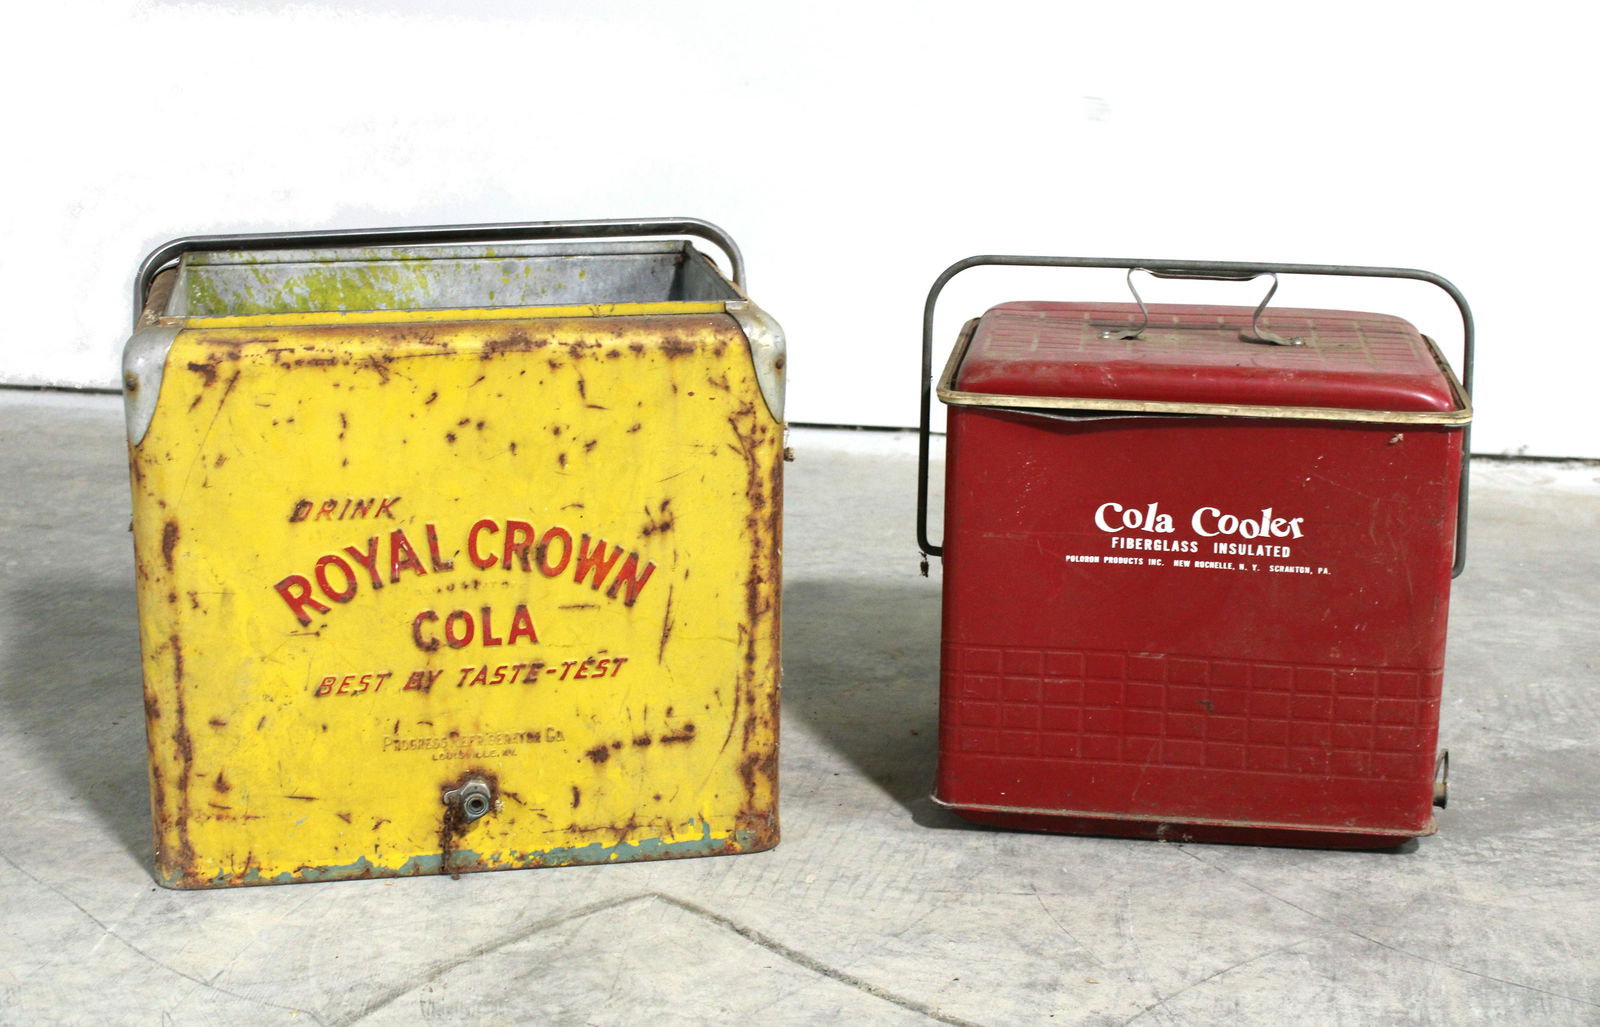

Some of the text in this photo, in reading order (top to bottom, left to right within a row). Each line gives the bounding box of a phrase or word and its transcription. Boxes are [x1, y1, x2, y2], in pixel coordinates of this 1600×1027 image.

[288, 495, 402, 523] DRINK
[1094, 502, 1304, 540] Cola Cooler
[1111, 536, 1291, 558] FIBERGLASS INSULATED
[273, 518, 657, 628] ROYAL CROWN
[1103, 556, 1144, 566] PRODUCTS
[1147, 558, 1165, 567] INC.
[1173, 559, 1191, 568] NEW
[1194, 561, 1235, 571] ROCHELLE,
[1269, 565, 1313, 575] SCRANTON,
[1317, 567, 1332, 575] PA.
[411, 603, 539, 653] COLA
[314, 656, 629, 698] BEST BY TASTE-TEST
[450, 730, 541, 747] EFRGERATOR
